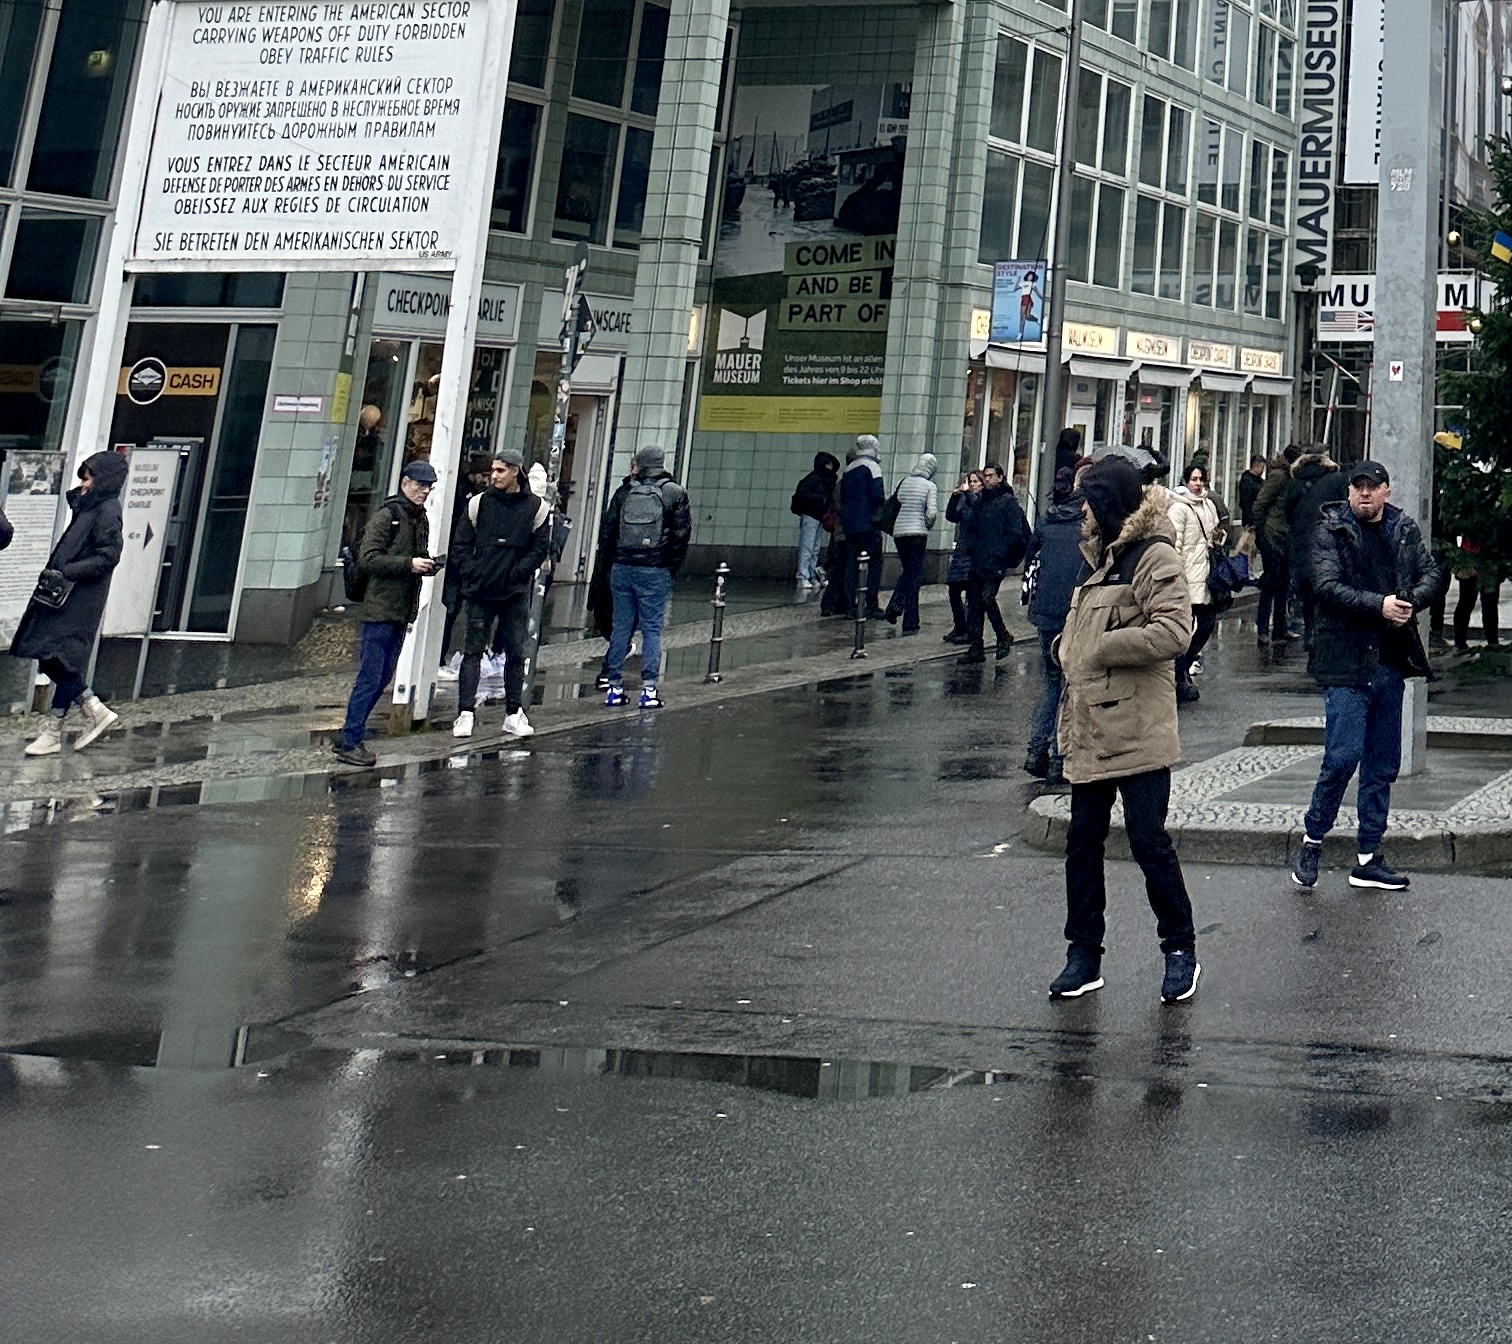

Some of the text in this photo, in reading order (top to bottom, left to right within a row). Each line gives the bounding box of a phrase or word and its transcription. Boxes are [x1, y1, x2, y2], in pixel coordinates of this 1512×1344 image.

[199, 1, 471, 23] YOU ARE ENTERING THE AMERICAN SECTOR
[193, 22, 466, 44] CARRYING WEAPONS OFF DUTY FORBIDDEN
[260, 45, 394, 64] OBEY TRAFFIC RULES
[190, 76, 453, 98] ВЫ ВЕЗЖАЕТЕ В АМЕРИКАНСКИЙ СЕКТОР
[175, 98, 460, 120] НОСИТЬ ОРУЖИЕ ЗАПРЕЩЕНО В НЕСЛУЖЕБНОЕ ВРЕМЯ
[281, 122, 357, 140] ДОРОЖНЫМ
[364, 120, 436, 139] ПРАВИЛАМ
[168, 154, 450, 173] VOUS ENTREZ DANS LE SECTEUR AMERICAIN
[163, 174, 451, 194] DEFENSE DE PORTER DES ARMES EN DEHORS DU SERVICE
[174, 196, 430, 214] OBEISSEZ AUX REGLES DE CIRCULATION
[153, 230, 439, 251] SIE BETRETEN DEN AMERIKANISCHEN SEKTOR
[796, 243, 862, 266] COME
[796, 276, 873, 295] AND BE
[387, 289, 451, 317] CHECKPOIN
[789, 303, 886, 323] PART OF
[715, 353, 762, 370] MAUER
[785, 354, 808, 362] Unser
[808, 354, 841, 362] Museum
[843, 354, 853, 362] ist
[864, 354, 883, 363] allen
[713, 370, 760, 384] MUSEUM
[783, 365, 798, 373] des
[799, 366, 824, 374] Jahres
[847, 366, 858, 374] bis
[859, 366, 868, 374] 22
[169, 373, 214, 389] CASH
[782, 376, 811, 385] Tickets
[812, 376, 828, 385] hier
[829, 376, 839, 385] im
[840, 376, 861, 386] Shop
